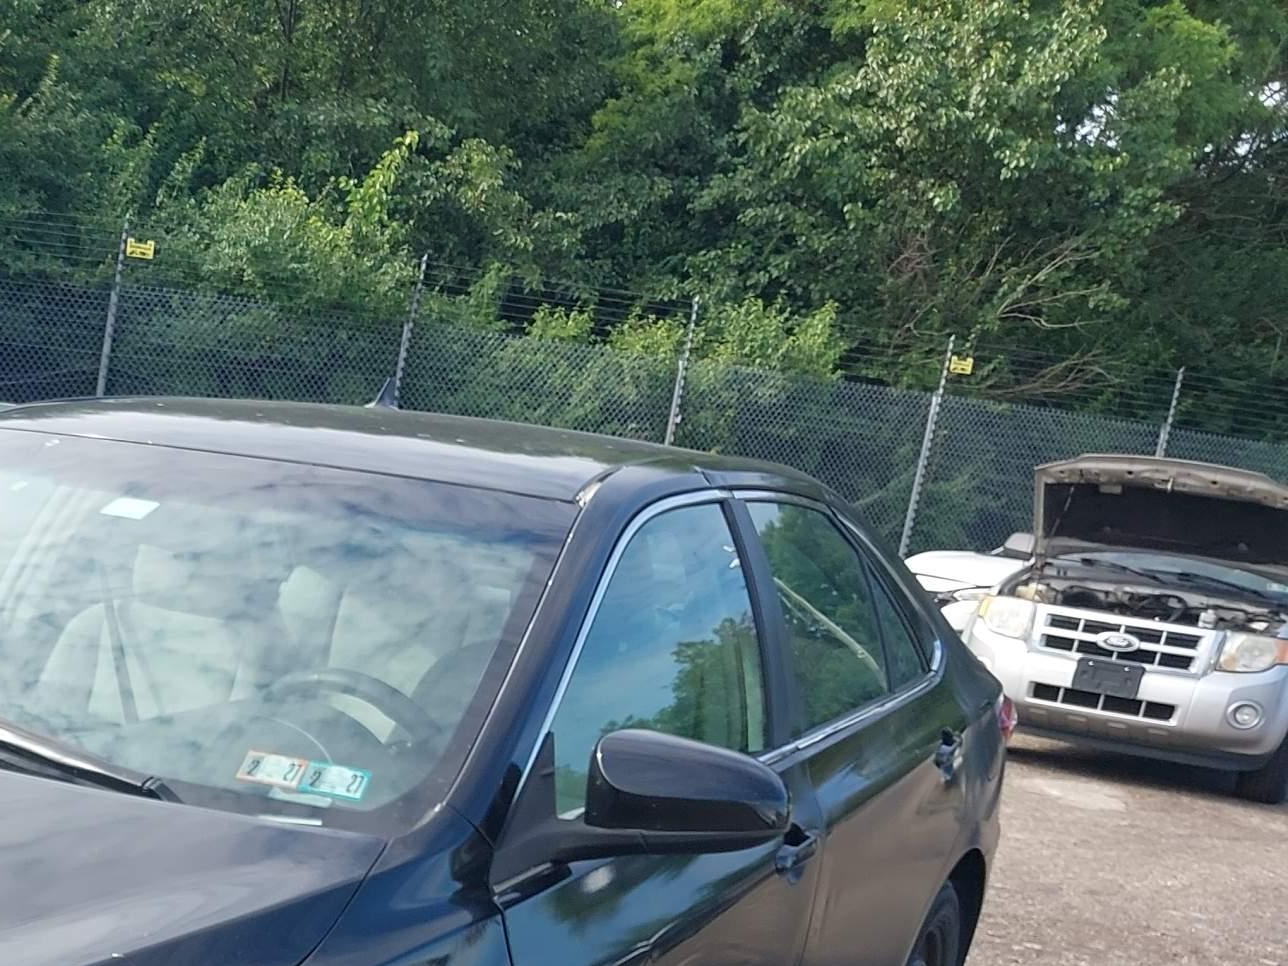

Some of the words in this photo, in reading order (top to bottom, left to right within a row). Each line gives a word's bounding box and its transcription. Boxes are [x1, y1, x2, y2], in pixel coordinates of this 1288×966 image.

[247, 759, 260, 776] 2
[283, 763, 302, 782] 27
[309, 770, 322, 787] 2
[346, 774, 365, 794] 27
